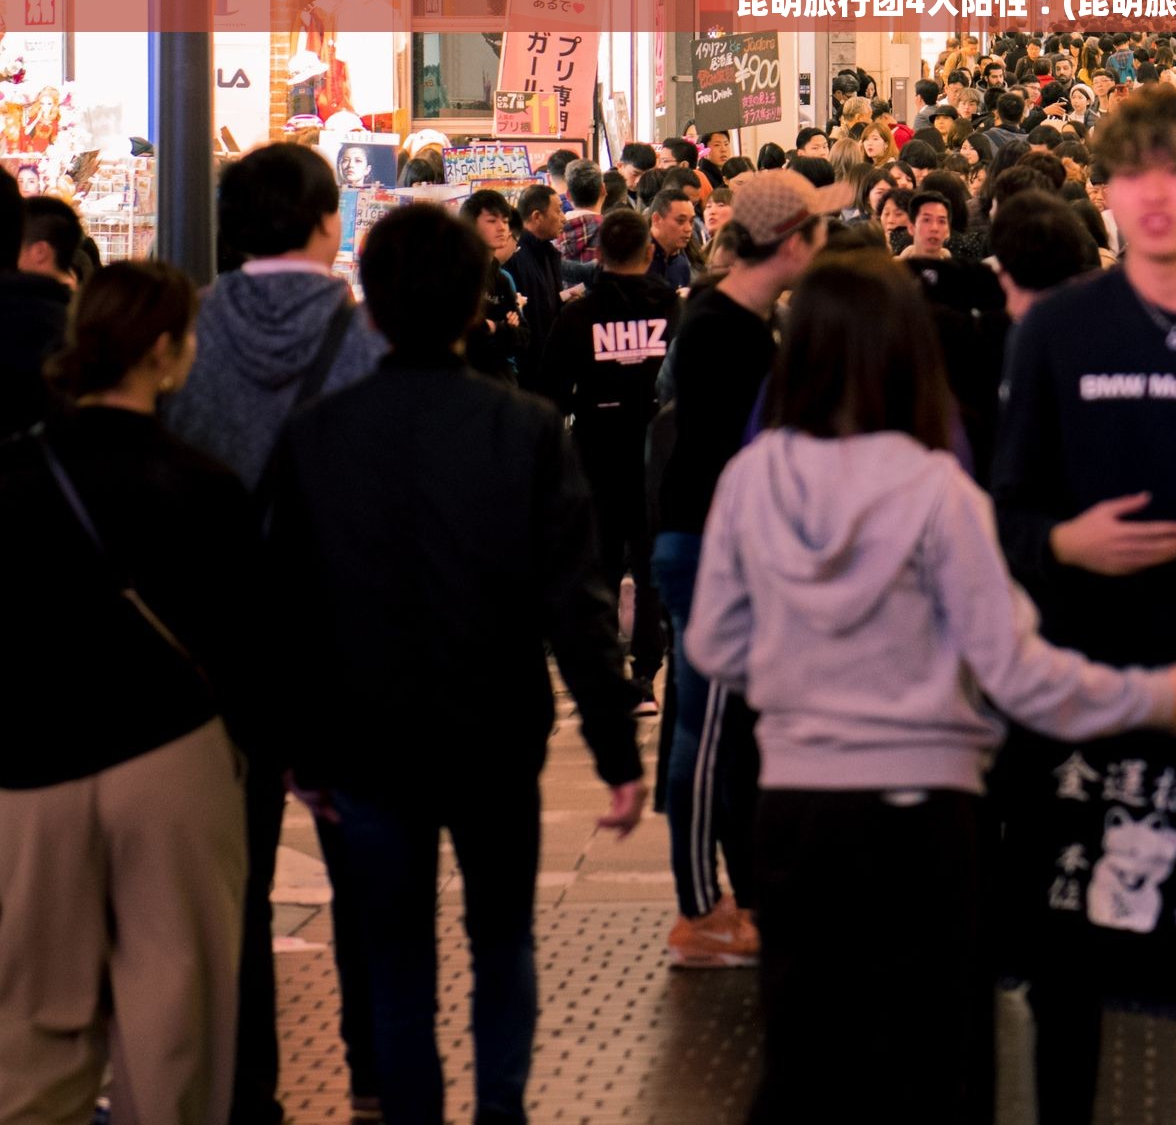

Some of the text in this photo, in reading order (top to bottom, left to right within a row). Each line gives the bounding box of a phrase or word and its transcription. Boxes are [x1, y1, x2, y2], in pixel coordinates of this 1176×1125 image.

[217, 67, 251, 88] LA
[734, 53, 780, 93] ¥900
[695, 87, 733, 105] Free Drink
[498, 122, 532, 133] プリ機
[525, 94, 556, 134] 11
[592, 318, 667, 353] NHIZ
[1080, 373, 1147, 401] BMW
